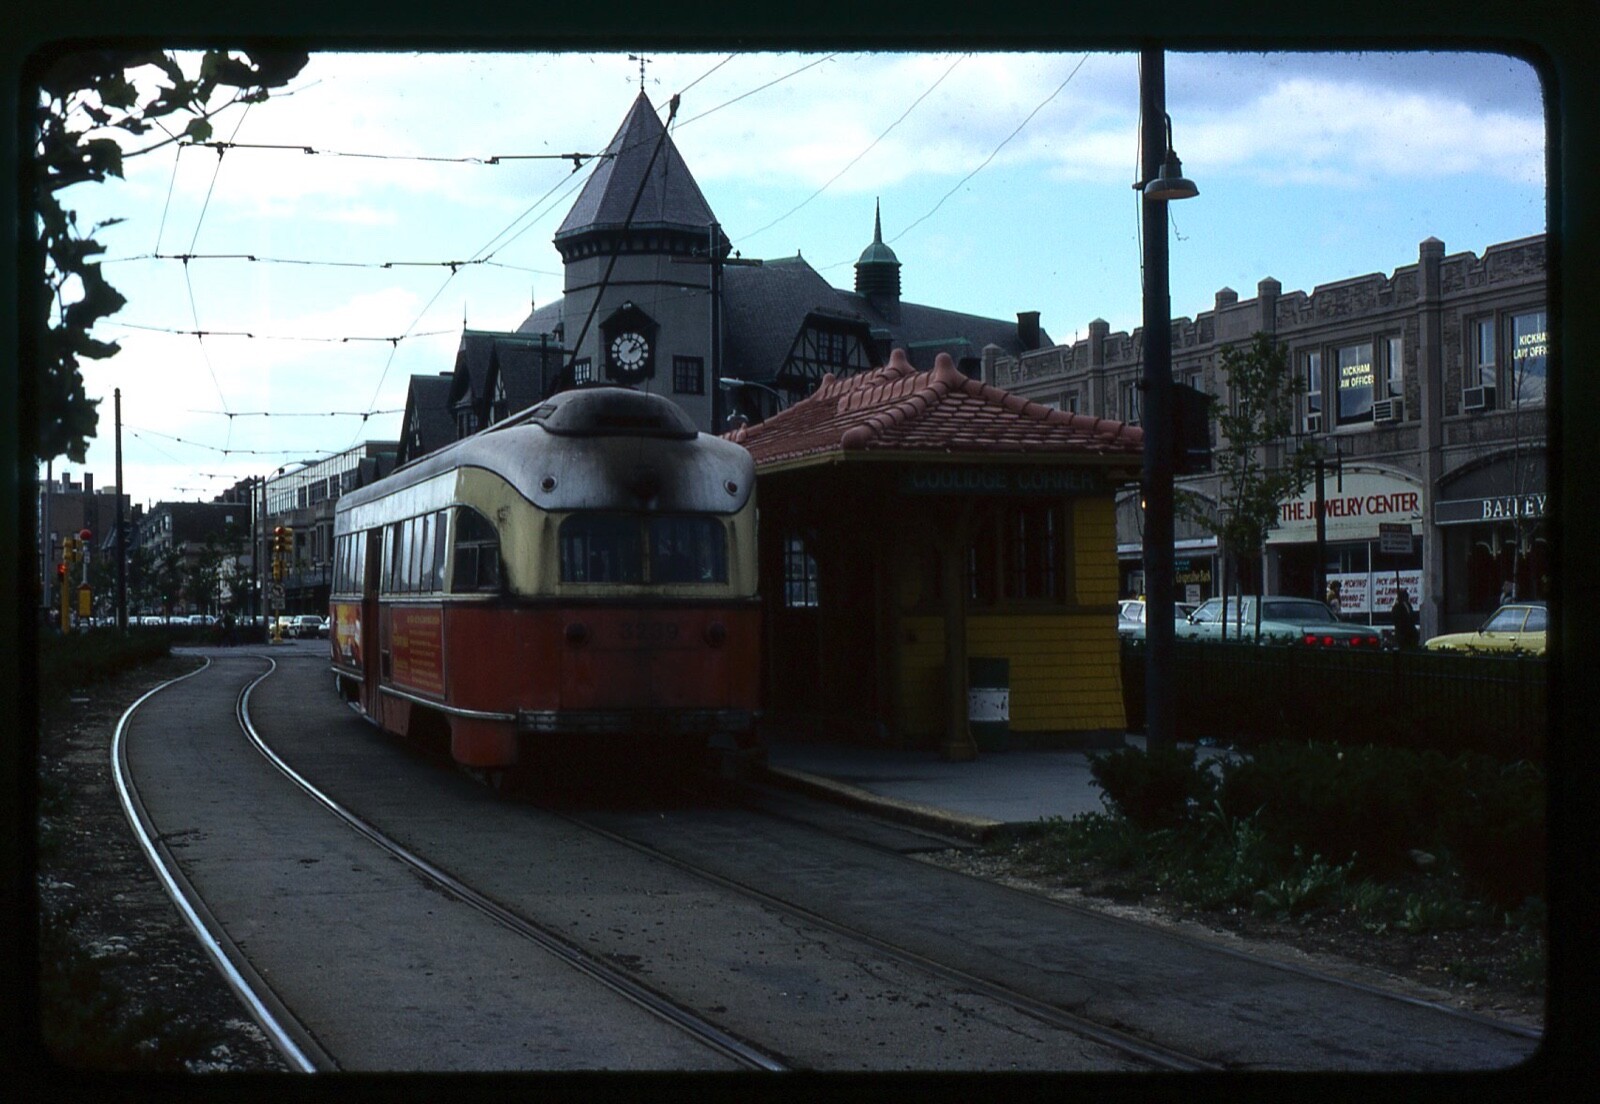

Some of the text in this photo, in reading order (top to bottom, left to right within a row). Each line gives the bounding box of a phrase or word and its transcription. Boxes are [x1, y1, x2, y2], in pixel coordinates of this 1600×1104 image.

[1342, 363, 1371, 377] KICKHAM
[1017, 470, 1096, 490] CORNER
[1281, 502, 1304, 521] THE
[1366, 492, 1419, 516] CENTER
